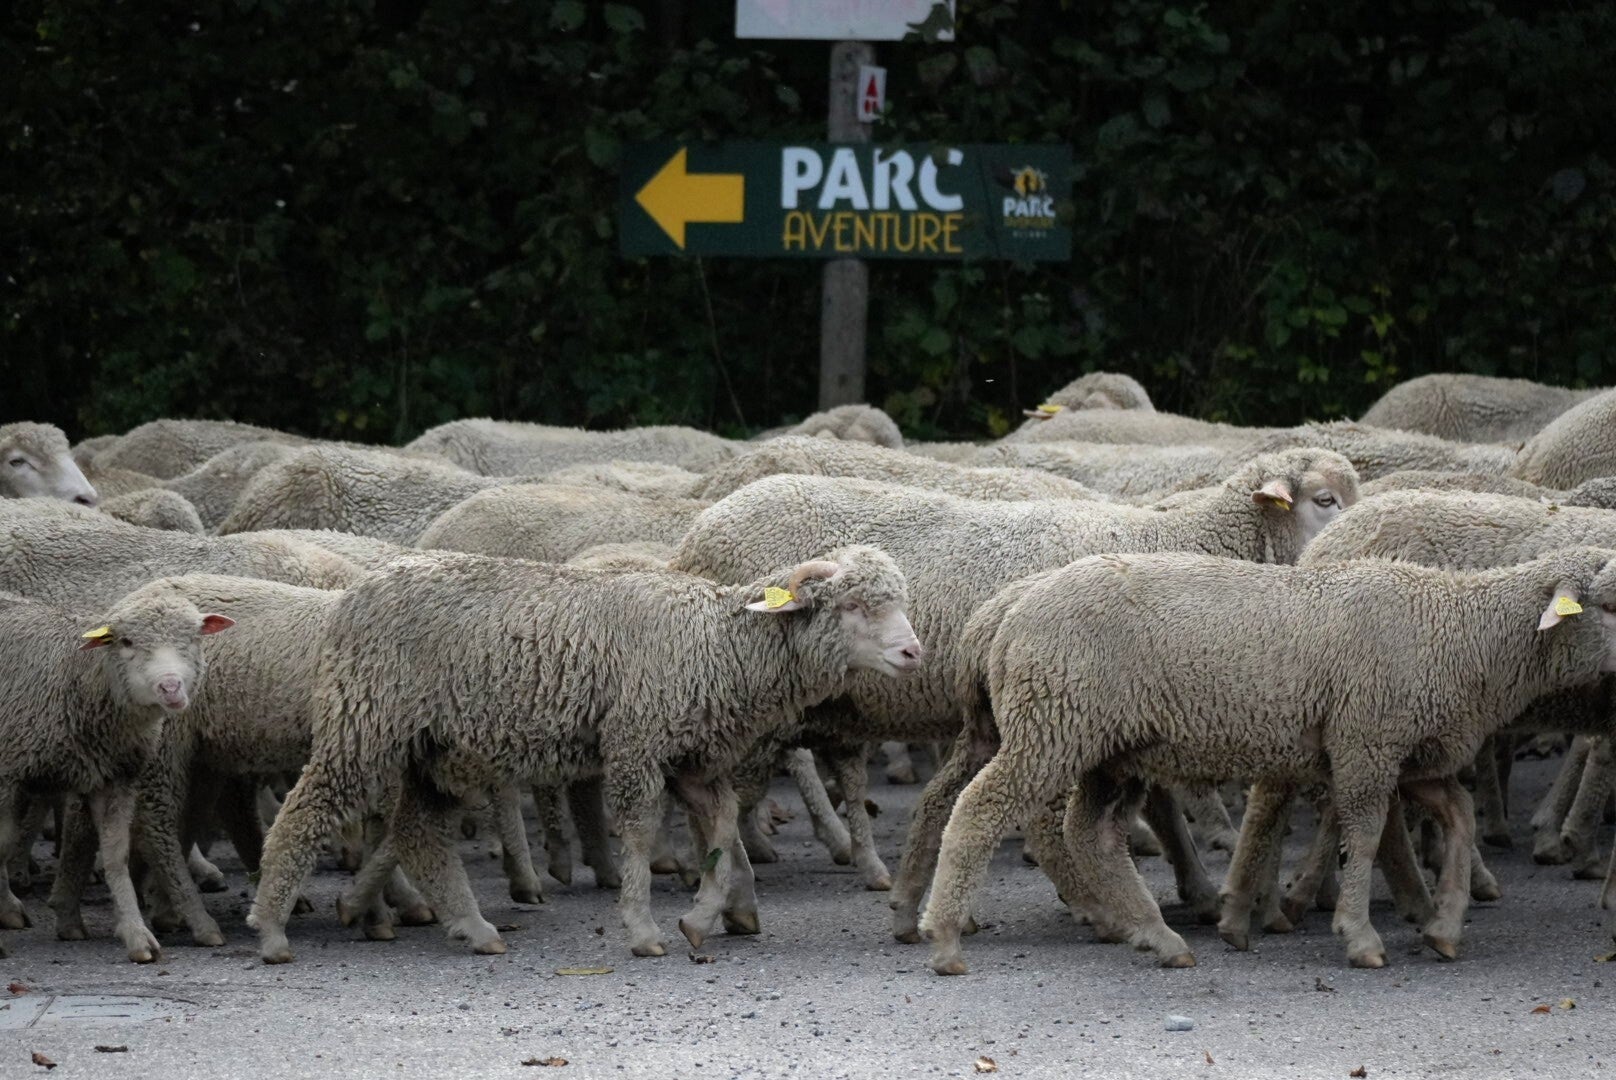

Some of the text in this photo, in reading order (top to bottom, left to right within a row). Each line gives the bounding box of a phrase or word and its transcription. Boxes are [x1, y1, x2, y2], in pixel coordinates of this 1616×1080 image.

[781, 147, 964, 211] PARC
[1003, 196, 1056, 217] PARC
[783, 211, 964, 252] AVENTURE
